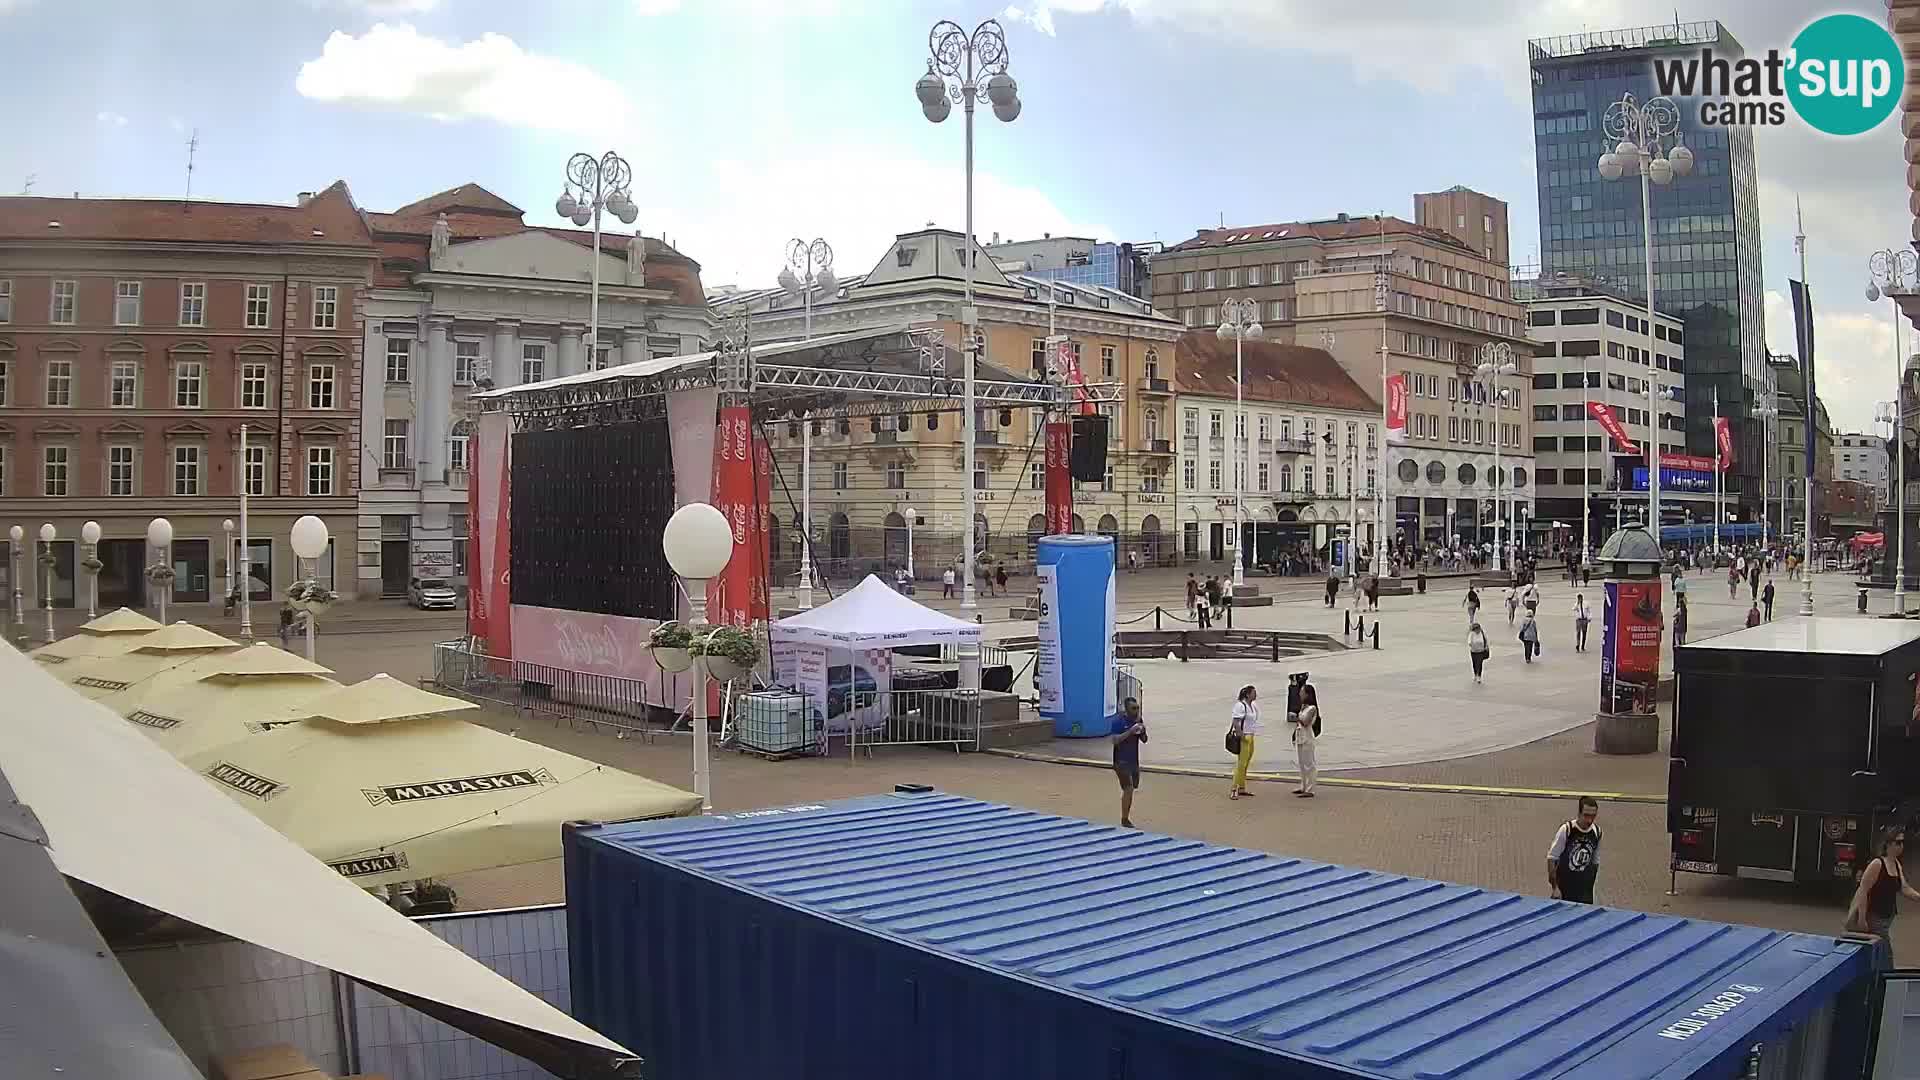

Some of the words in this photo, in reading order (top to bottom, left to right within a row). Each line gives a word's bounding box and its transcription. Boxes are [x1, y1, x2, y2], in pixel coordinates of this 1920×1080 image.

[216, 764, 273, 797] MARASKA
[394, 773, 531, 799] MARASKA
[1690, 990, 1746, 1020] 300629
